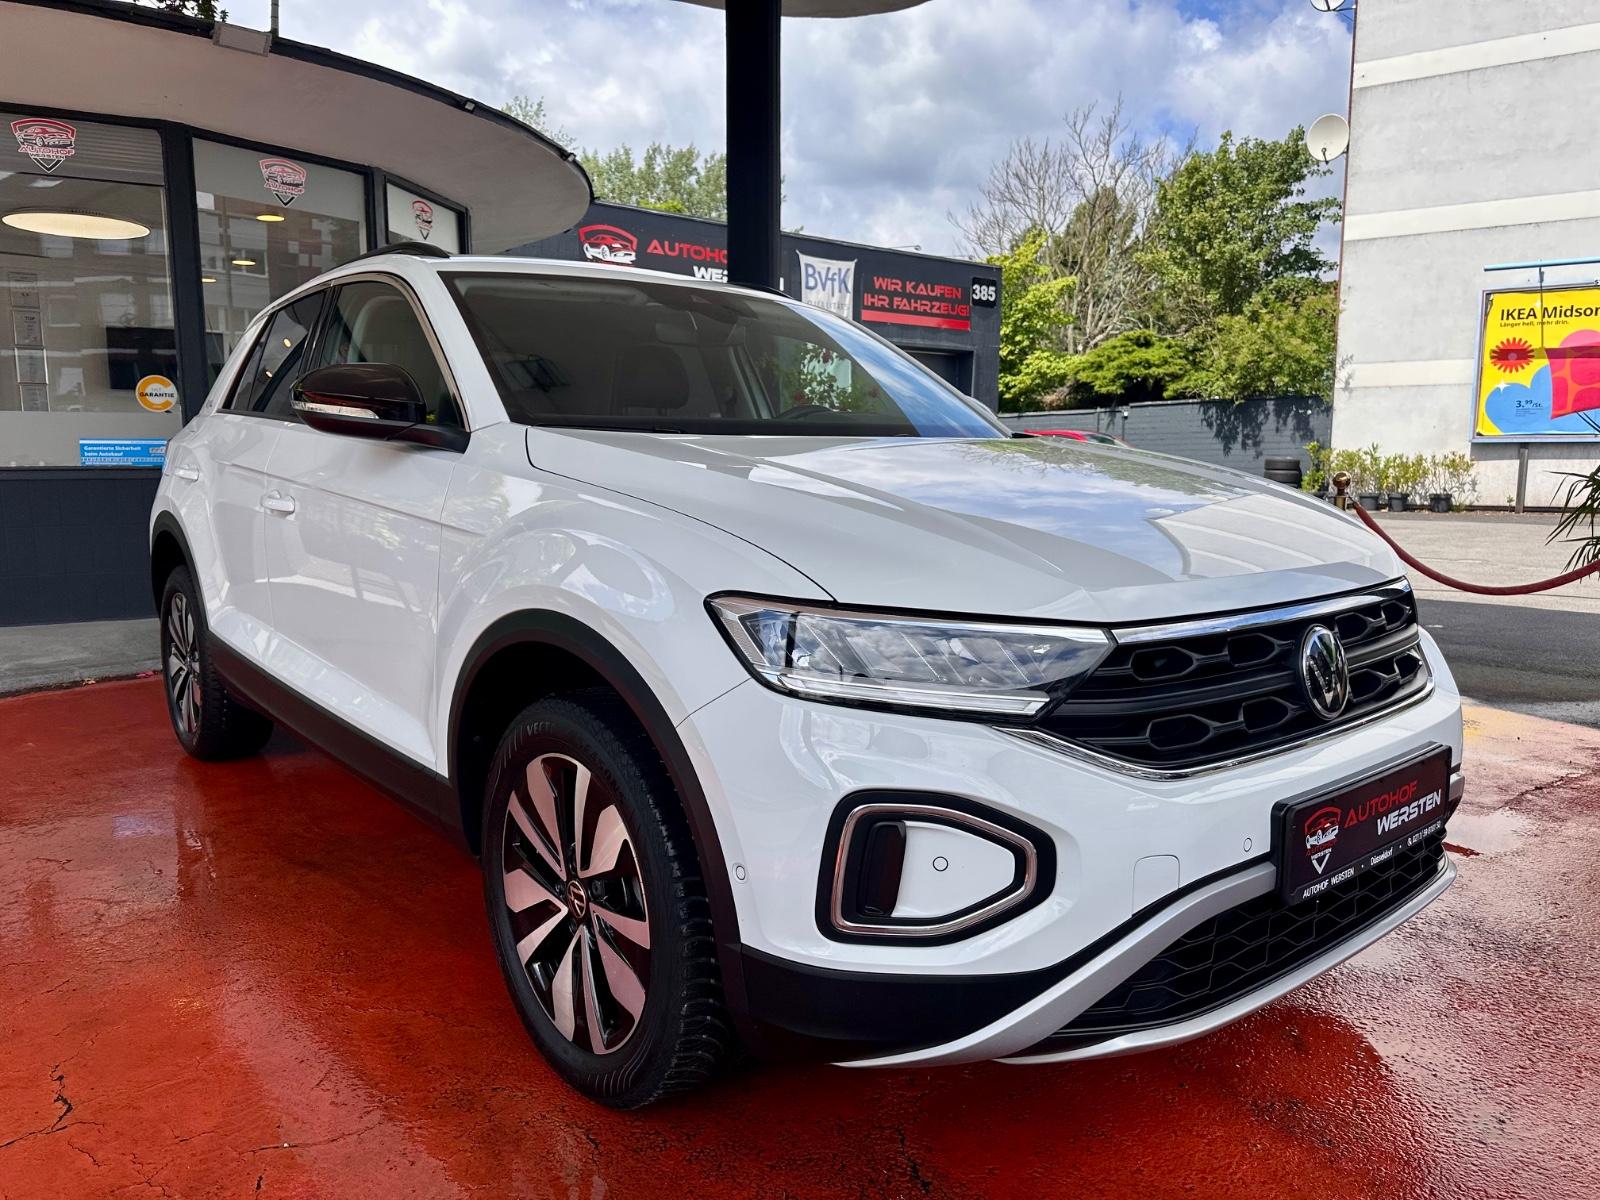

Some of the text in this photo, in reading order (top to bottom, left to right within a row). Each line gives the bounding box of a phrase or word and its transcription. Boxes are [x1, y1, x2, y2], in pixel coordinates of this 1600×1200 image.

[18, 144, 75, 156] AUTOHOF
[646, 239, 728, 265] AUTOH
[873, 276, 962, 299] WIR KAUFEN
[972, 284, 996, 301] 385
[864, 293, 970, 316] IHR FAHRZEUG!
[1500, 308, 1538, 321] IKEA
[1344, 780, 1418, 828] AUTOHOF
[1377, 789, 1441, 836] WERSTEN
[1302, 879, 1329, 899] AUTOHOF
[1330, 867, 1355, 886] WERSTEN
[1370, 847, 1393, 866] Düsseldorf
